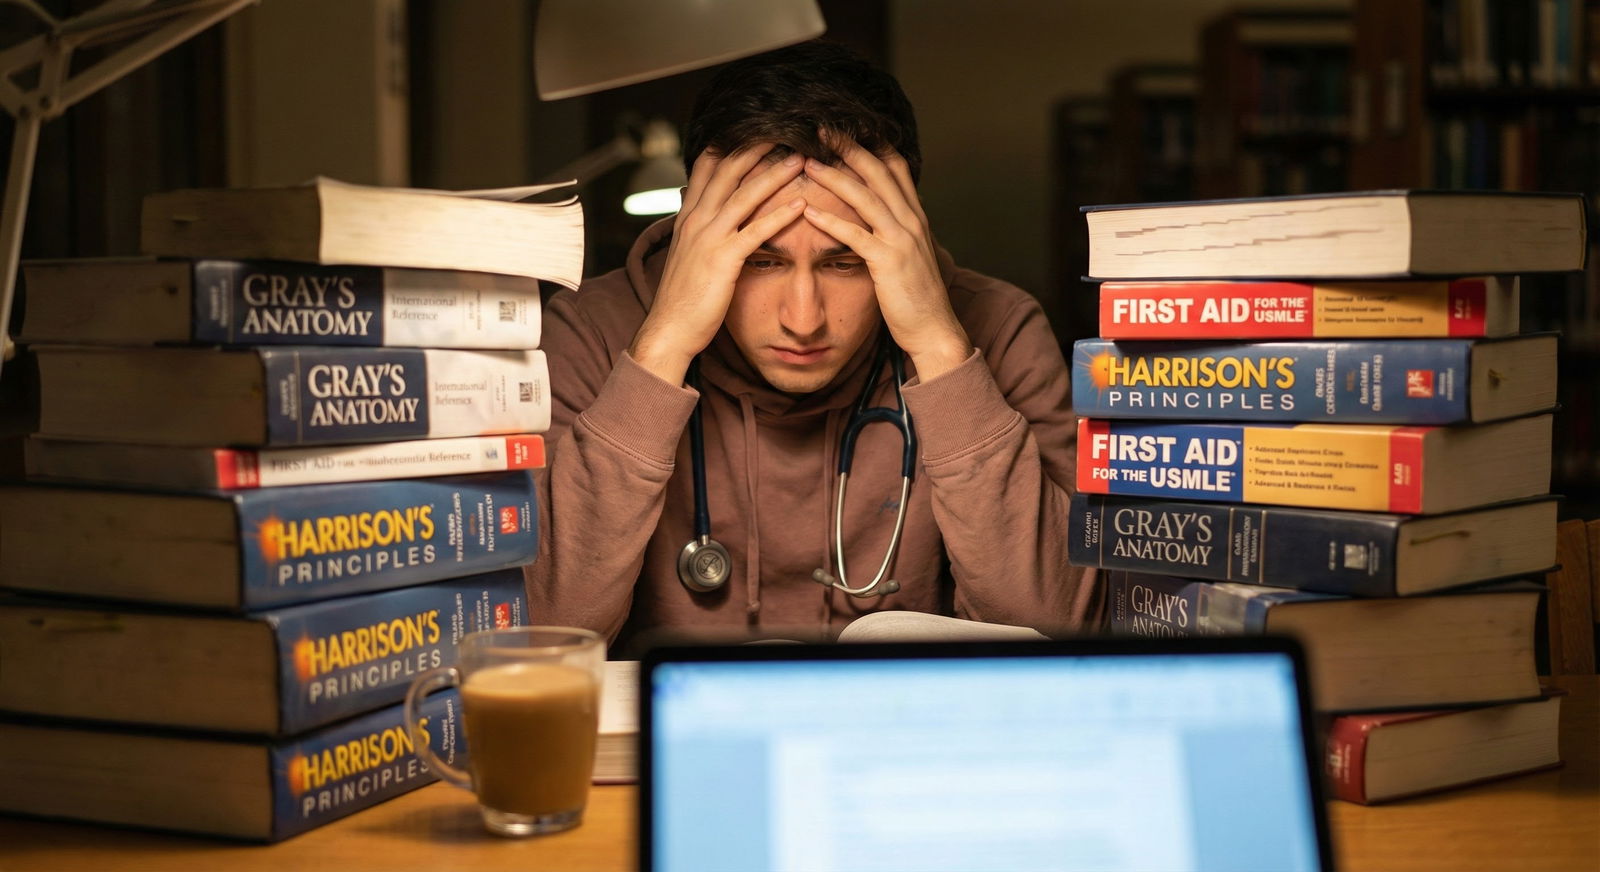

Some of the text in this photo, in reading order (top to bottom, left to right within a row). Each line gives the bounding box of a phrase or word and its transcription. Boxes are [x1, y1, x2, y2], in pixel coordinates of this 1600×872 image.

[243, 273, 356, 308] GRAY'S
[391, 294, 457, 307] International
[1254, 297, 1305, 309] FOR THE
[243, 308, 373, 336] ANATOMY
[1112, 298, 1250, 324] FIRST AID
[1254, 309, 1305, 323] USMLE
[308, 363, 407, 398] GRAY'S
[1108, 356, 1296, 389] HARRISON'S
[310, 397, 420, 427] ANATOMY
[1109, 391, 1295, 411] PRINCIPLES
[1091, 433, 1177, 464] FIRST
[1183, 437, 1239, 467] AID
[1091, 467, 1232, 492] FOR THE USMLE
[277, 504, 435, 560] HARRISON'S
[1113, 508, 1213, 543] GRAY'S
[278, 544, 436, 586] PRINCIPLES
[1113, 537, 1213, 566] ANATOMY
[1131, 584, 1189, 628] GRAY'S
[307, 609, 441, 678] HARRISON'S
[310, 649, 442, 704] PRINCIPLES
[302, 718, 431, 793] HARRISONS
